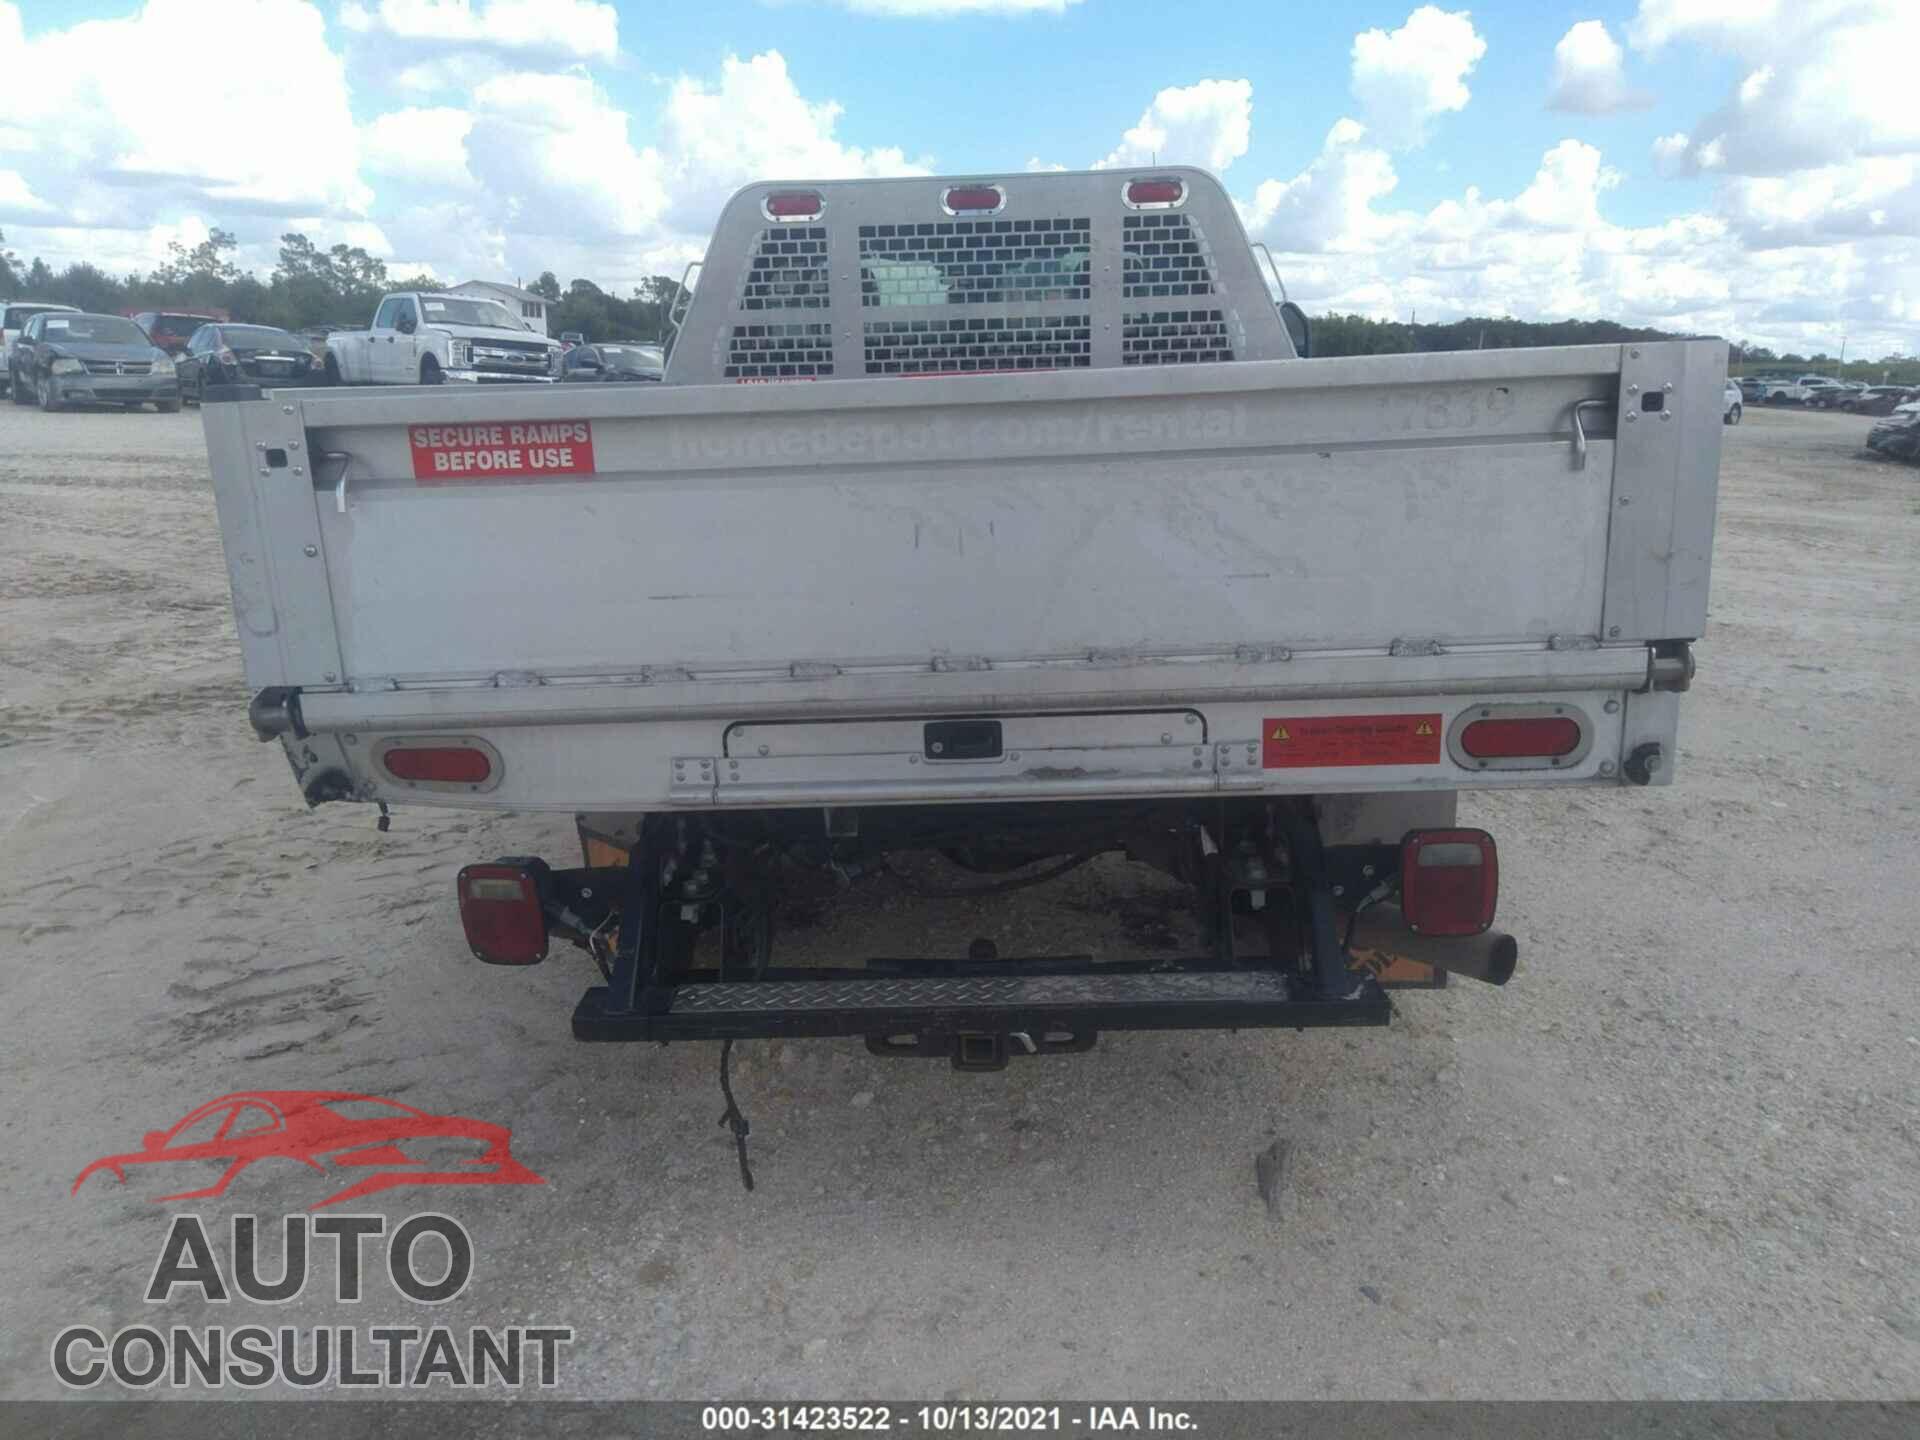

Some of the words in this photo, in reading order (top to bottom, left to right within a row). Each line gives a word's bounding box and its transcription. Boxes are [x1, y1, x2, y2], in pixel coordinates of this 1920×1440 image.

[415, 427, 504, 448] SECURE
[510, 423, 588, 445] RAMPS
[434, 450, 522, 471] BEFORE
[529, 448, 574, 468] USE
